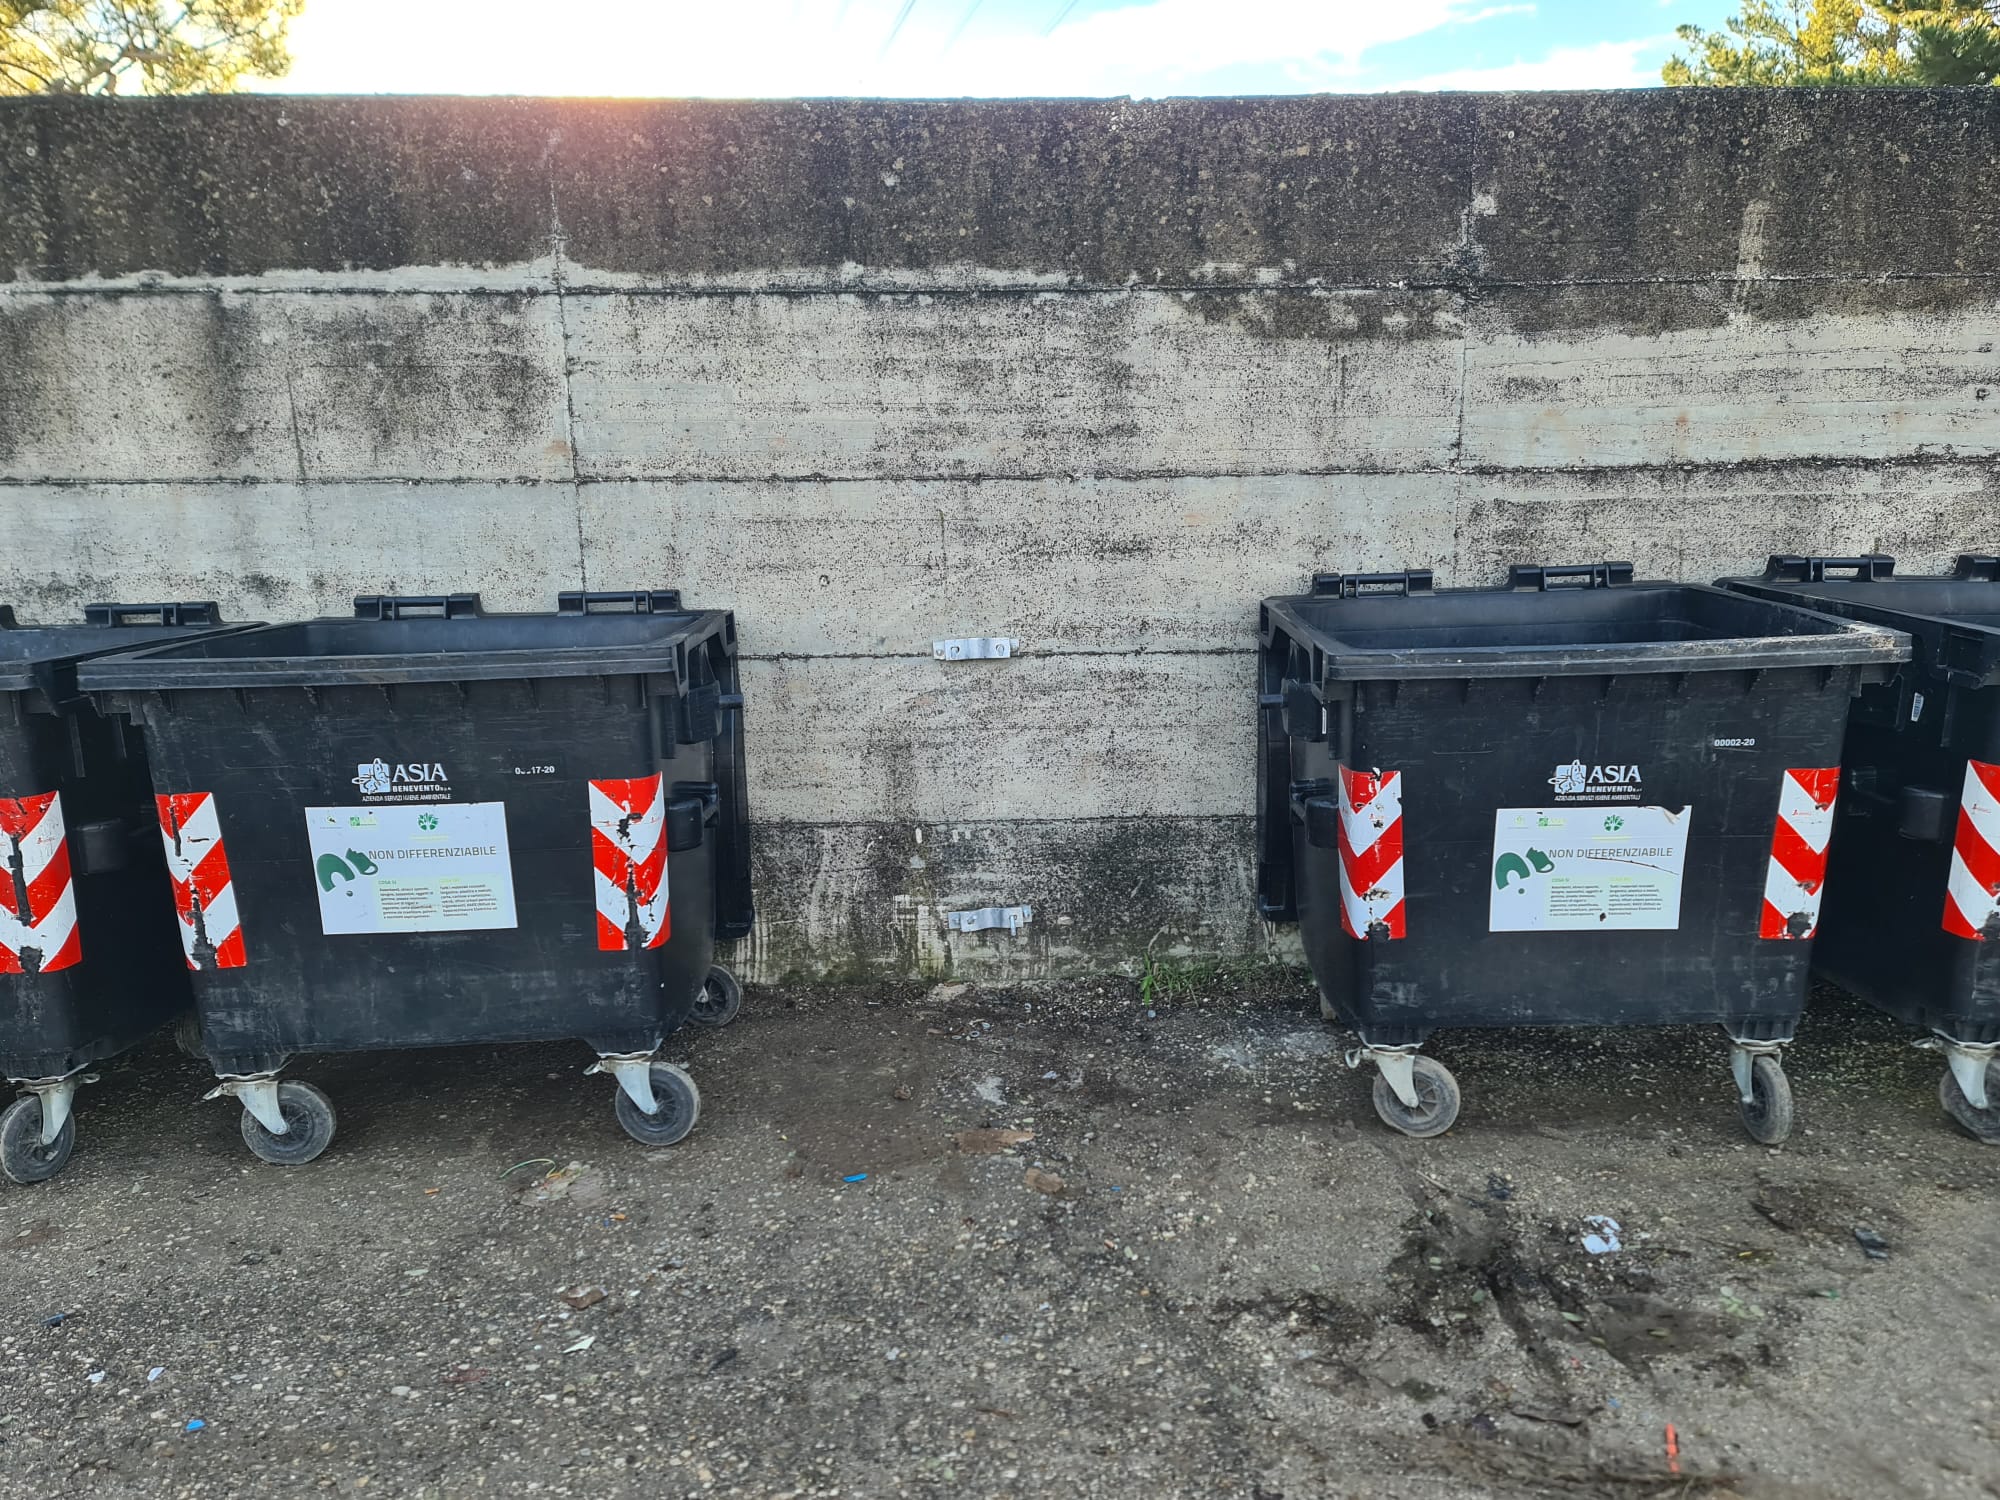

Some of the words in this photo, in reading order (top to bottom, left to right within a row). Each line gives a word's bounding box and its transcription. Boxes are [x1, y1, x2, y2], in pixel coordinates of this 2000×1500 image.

[1714, 738, 1755, 747] 00002-20
[392, 764, 448, 782] ASIA
[1587, 766, 1641, 783] ASIA
[368, 850, 395, 860] NON
[396, 845, 497, 860] DIFFERENZIABILE
[1549, 849, 1574, 859] NON
[1576, 847, 1674, 859] DIFFERENZIABILE
